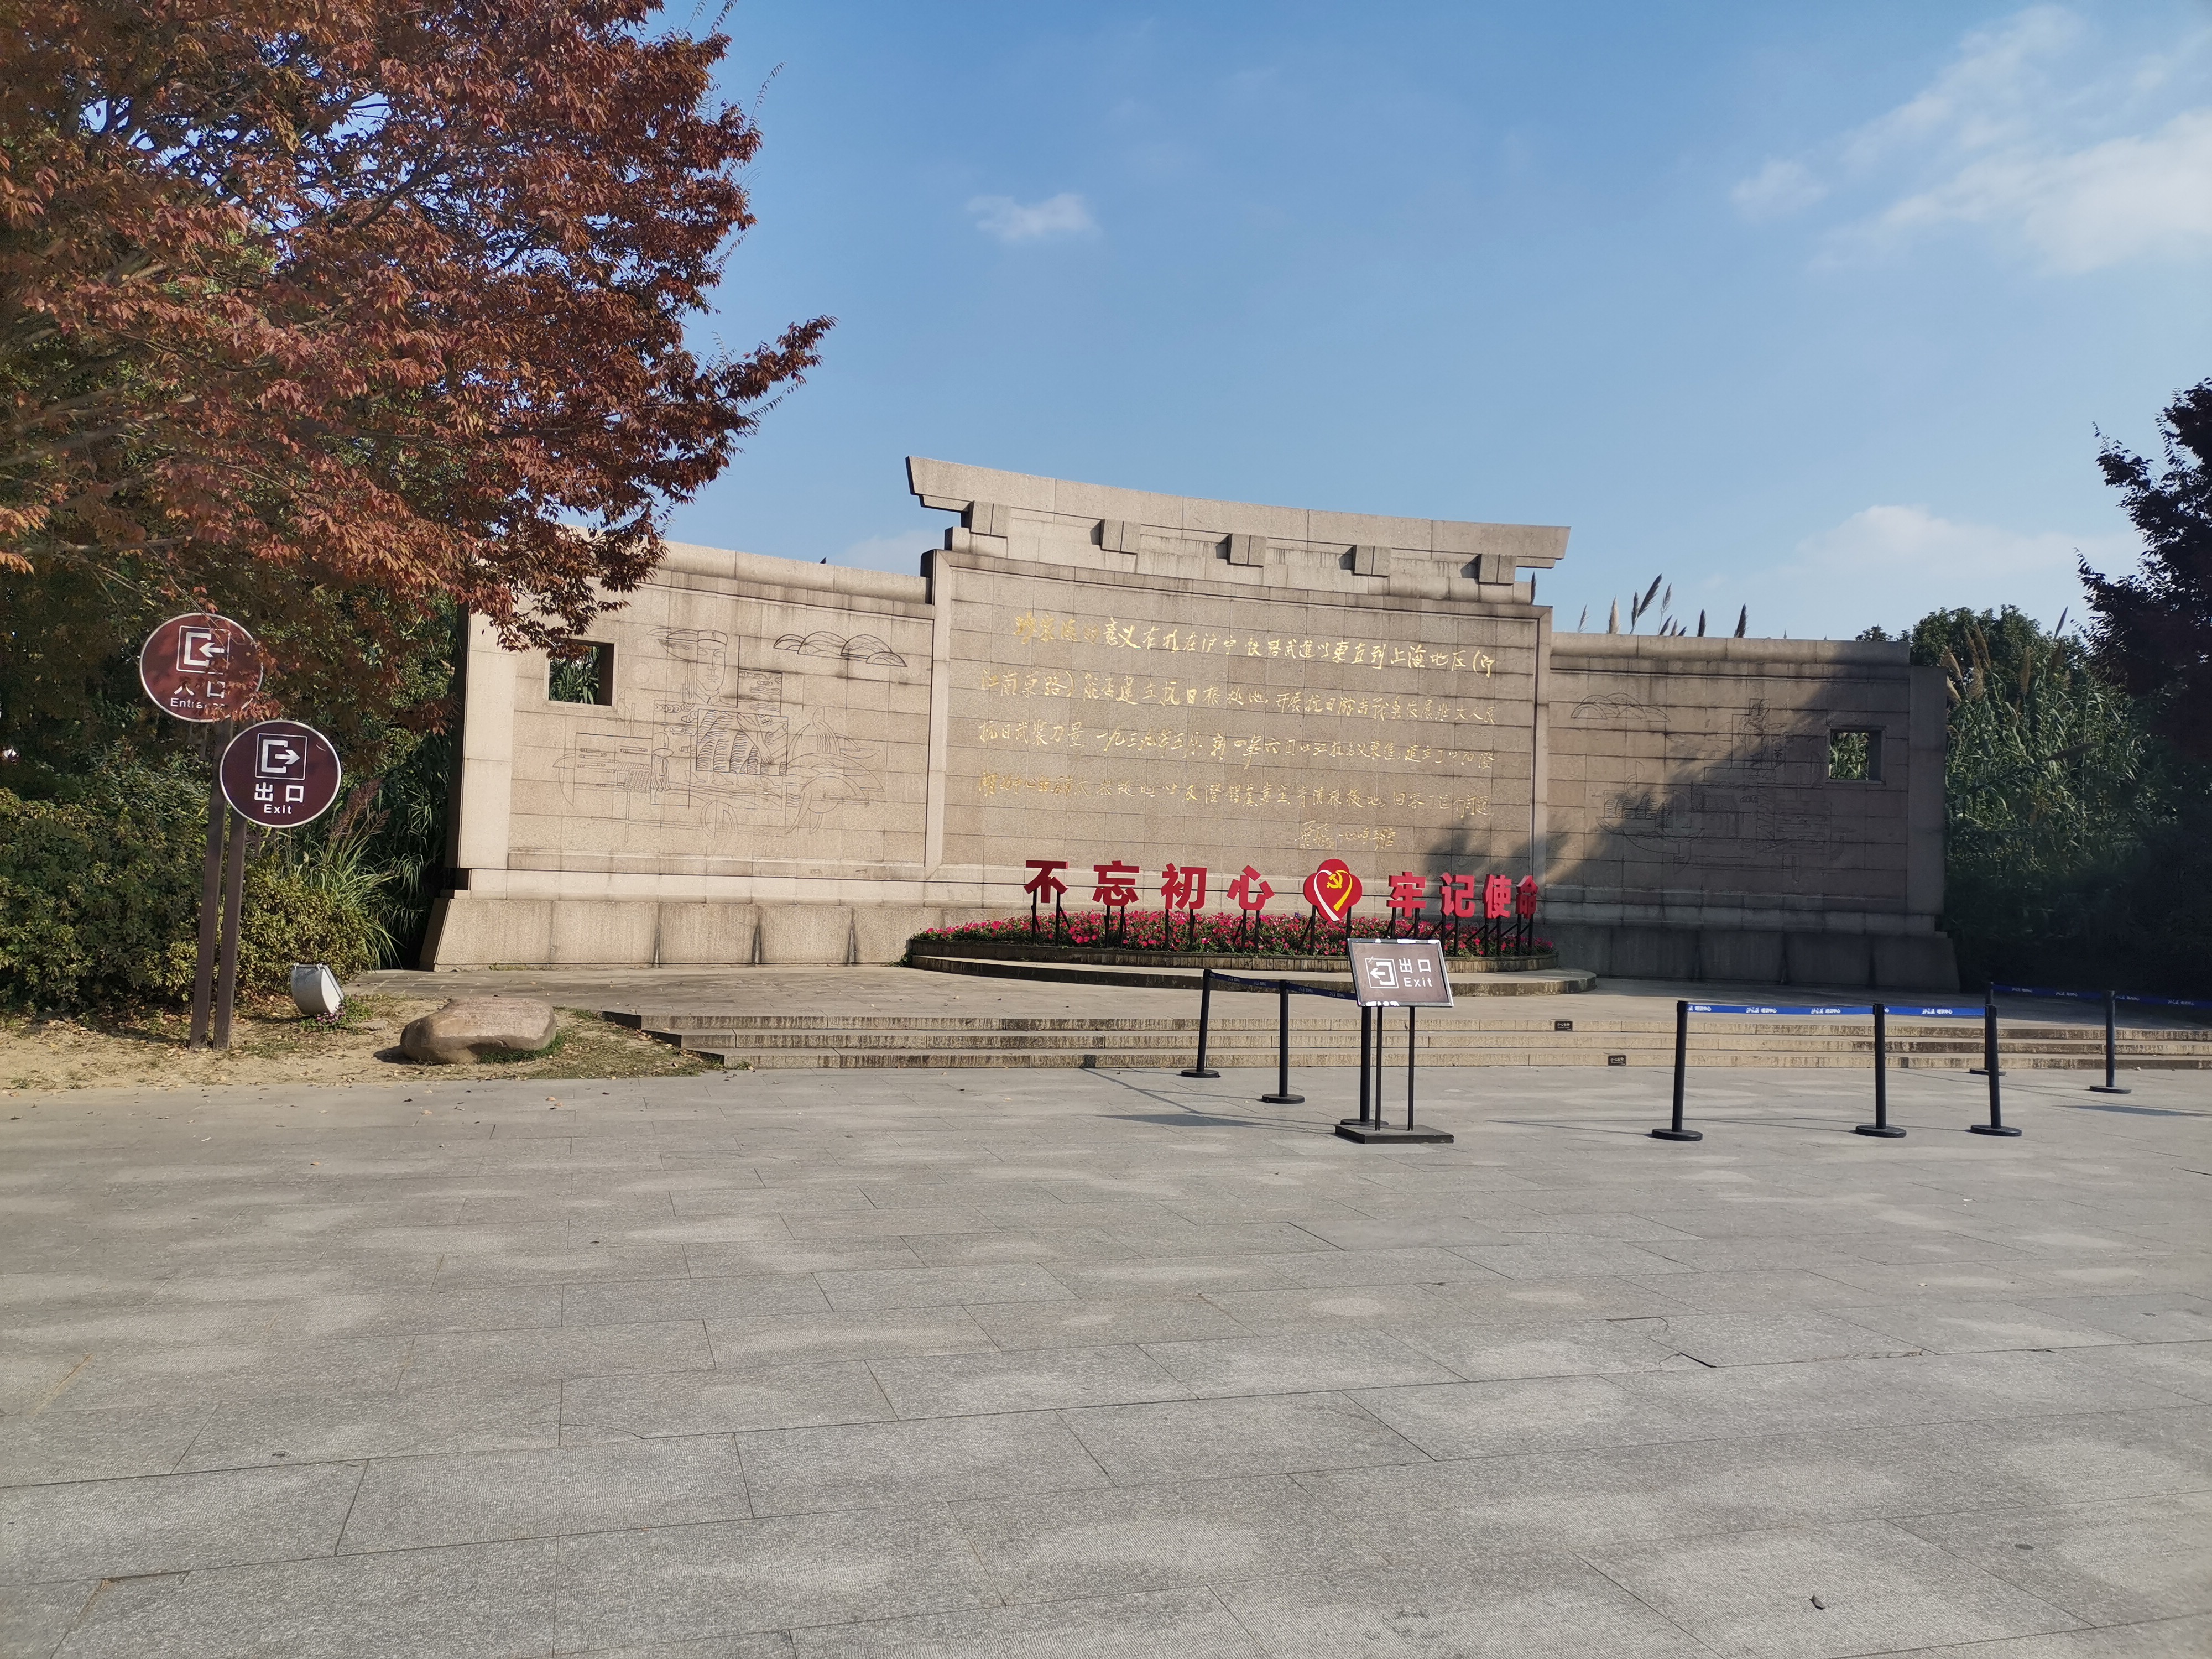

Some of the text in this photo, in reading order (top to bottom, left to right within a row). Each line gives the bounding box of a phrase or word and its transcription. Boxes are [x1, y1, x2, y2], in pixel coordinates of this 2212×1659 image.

[174, 680, 226, 698] 入口
[254, 782, 305, 803] 出口
[264, 804, 292, 815] Exit
[1024, 860, 1539, 919] 不忘初心 牢记使命
[1399, 957, 1432, 974] 出口
[1404, 977, 1433, 987] Exit
